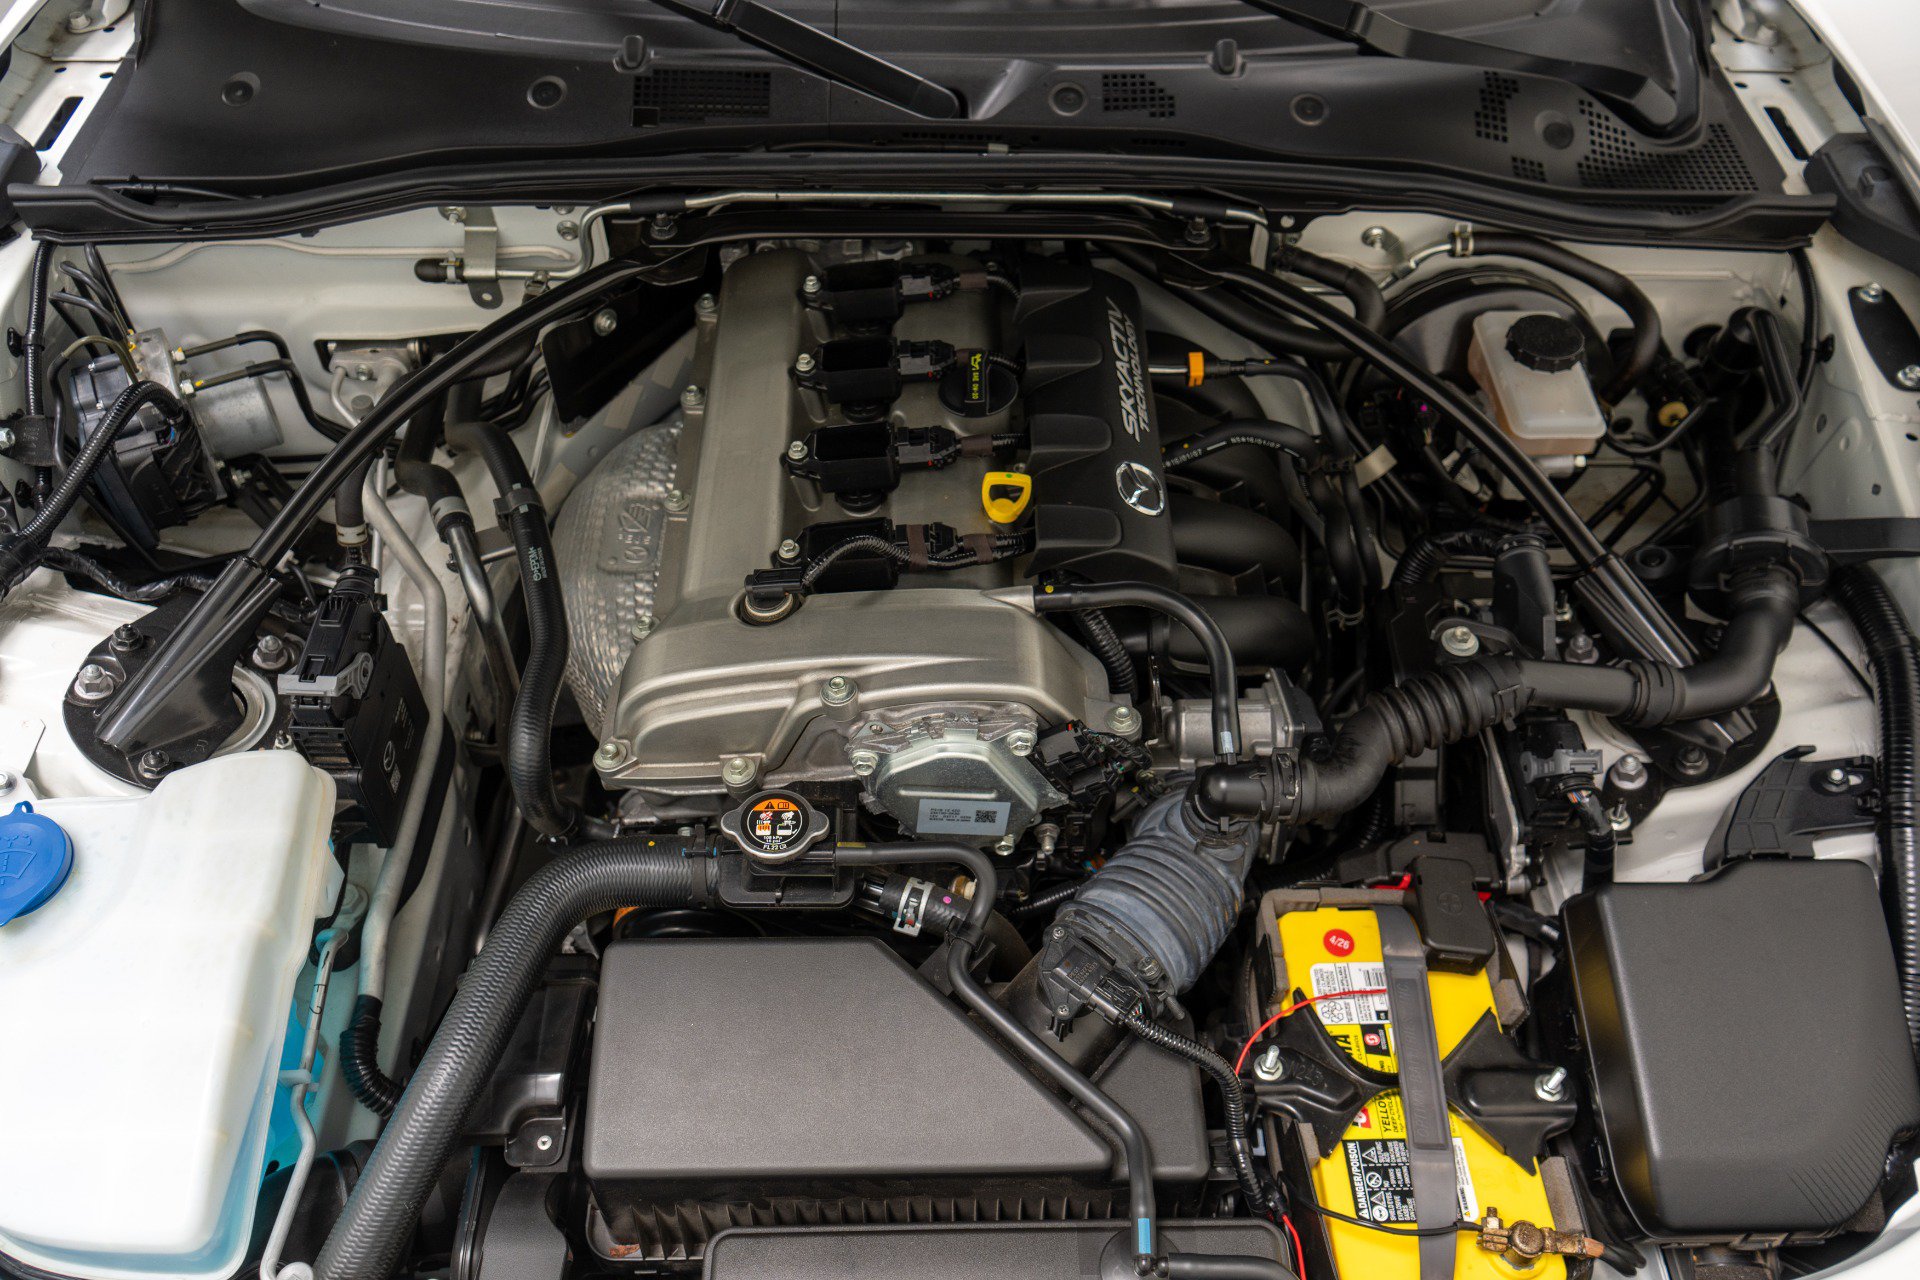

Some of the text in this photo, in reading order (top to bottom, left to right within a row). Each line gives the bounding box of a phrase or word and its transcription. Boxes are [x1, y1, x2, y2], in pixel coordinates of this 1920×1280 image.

[1106, 296, 1140, 442] SKYACTIV
[1123, 313, 1150, 432] TECHNOLOGY
[1329, 935, 1350, 950] 4/26
[1347, 1142, 1367, 1208] DANGER/POISON
[1388, 1204, 1397, 1221] SHIELD
